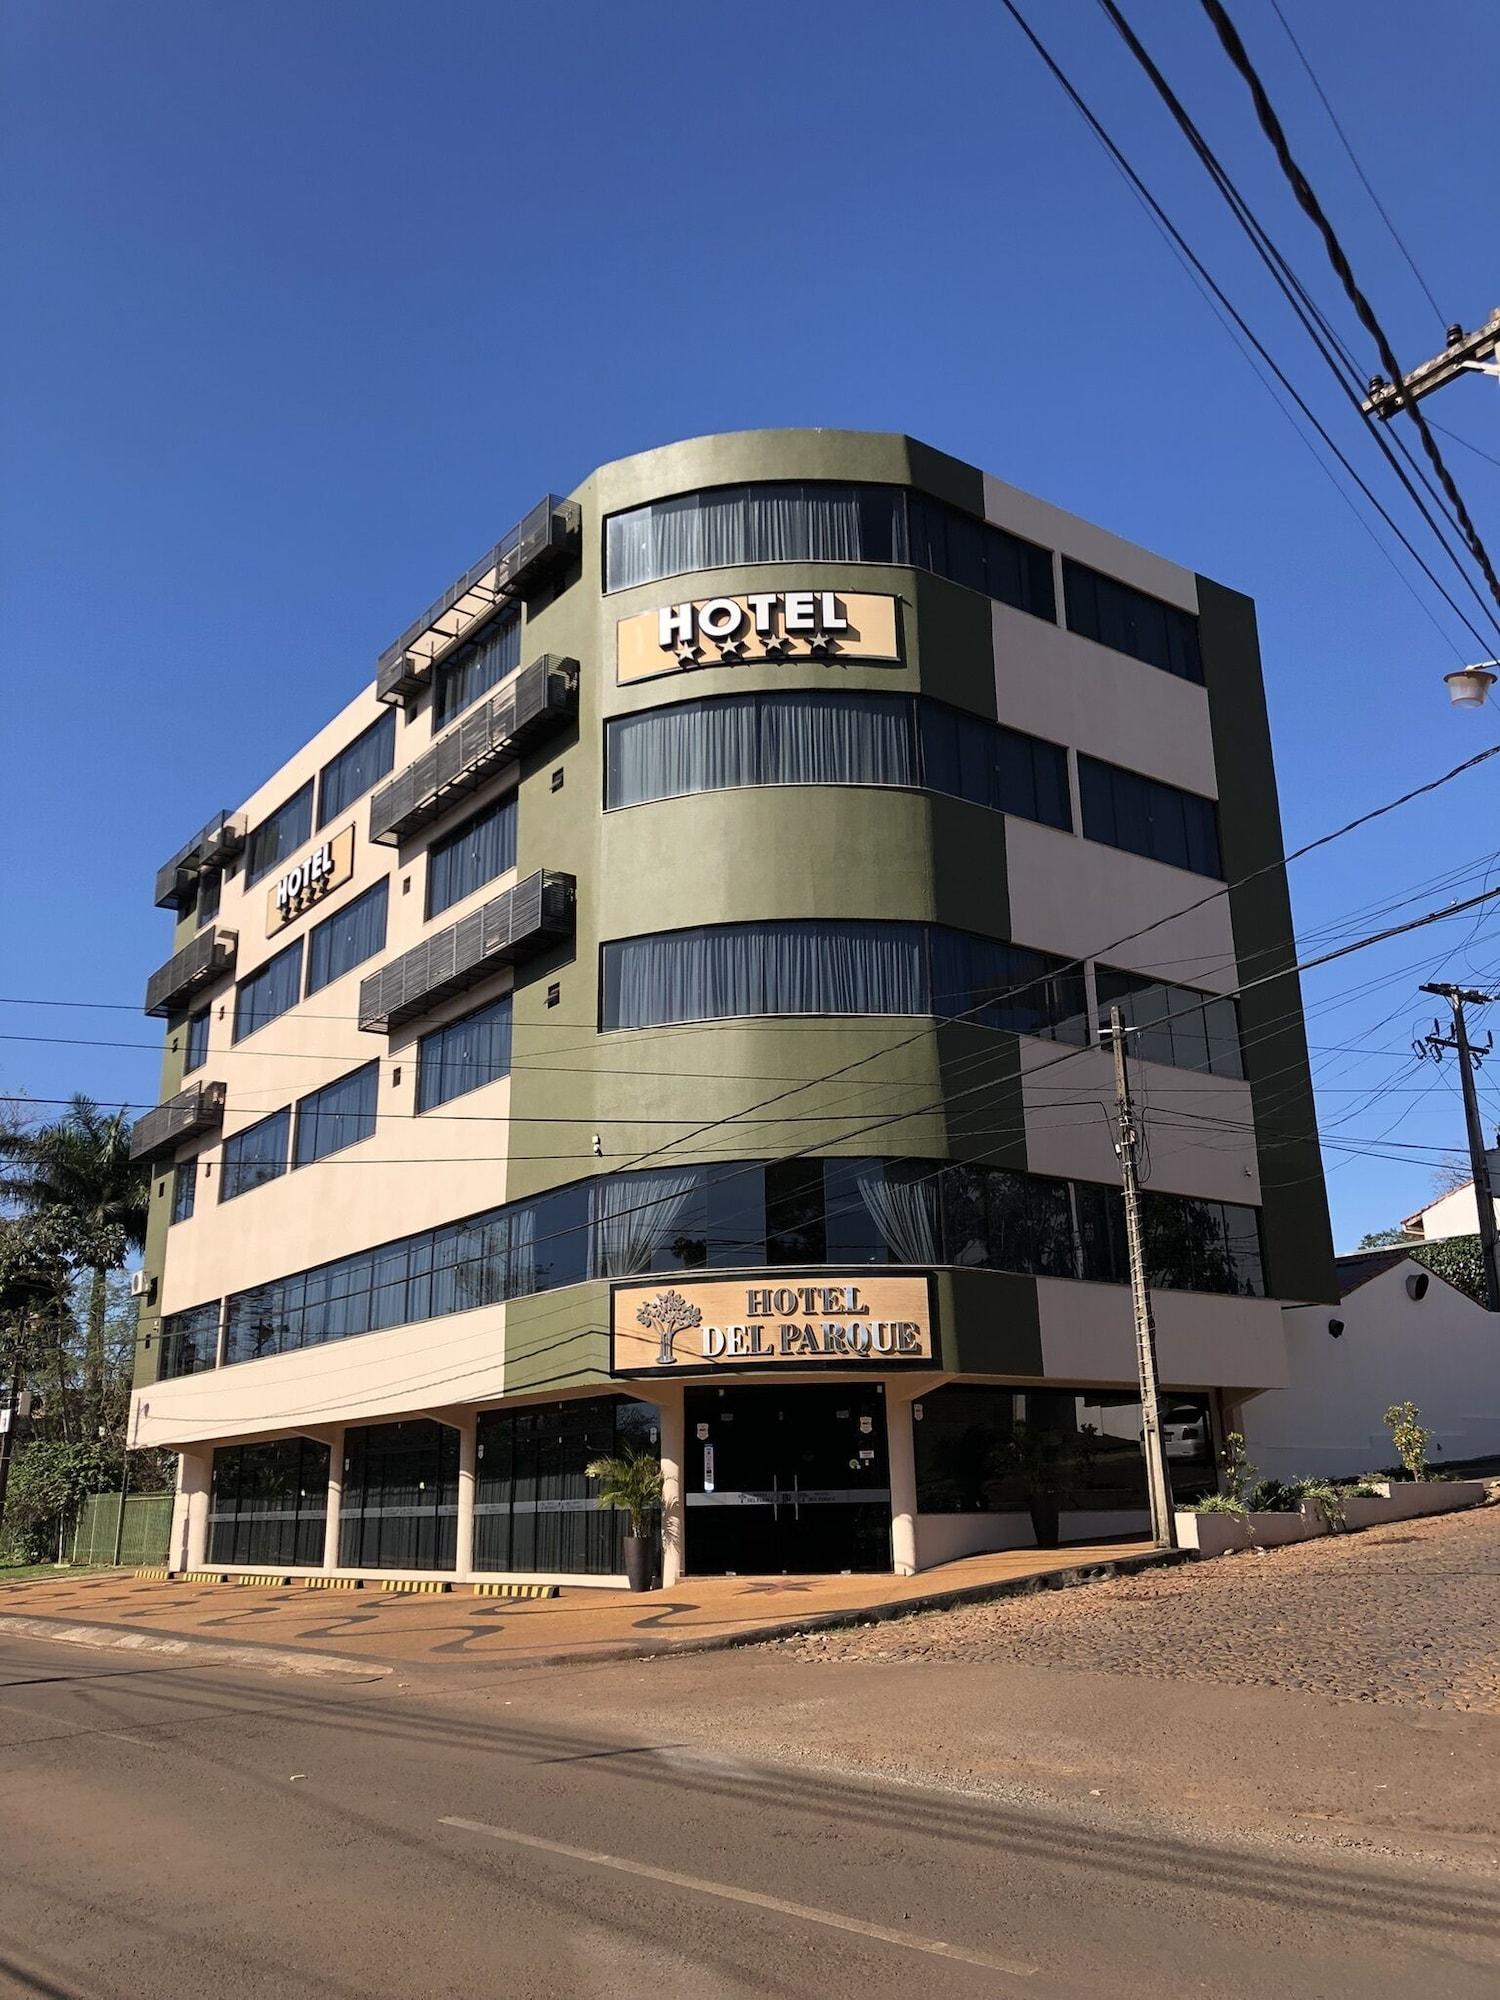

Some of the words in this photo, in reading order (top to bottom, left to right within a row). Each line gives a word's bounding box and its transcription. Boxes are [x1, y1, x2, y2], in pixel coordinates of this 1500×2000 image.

[658, 591, 849, 649] HOTEL
[276, 842, 334, 909] HOTEL
[746, 1286, 870, 1317] HOTEL
[701, 1324, 775, 1358] DEL
[778, 1321, 922, 1358] PARQUE
